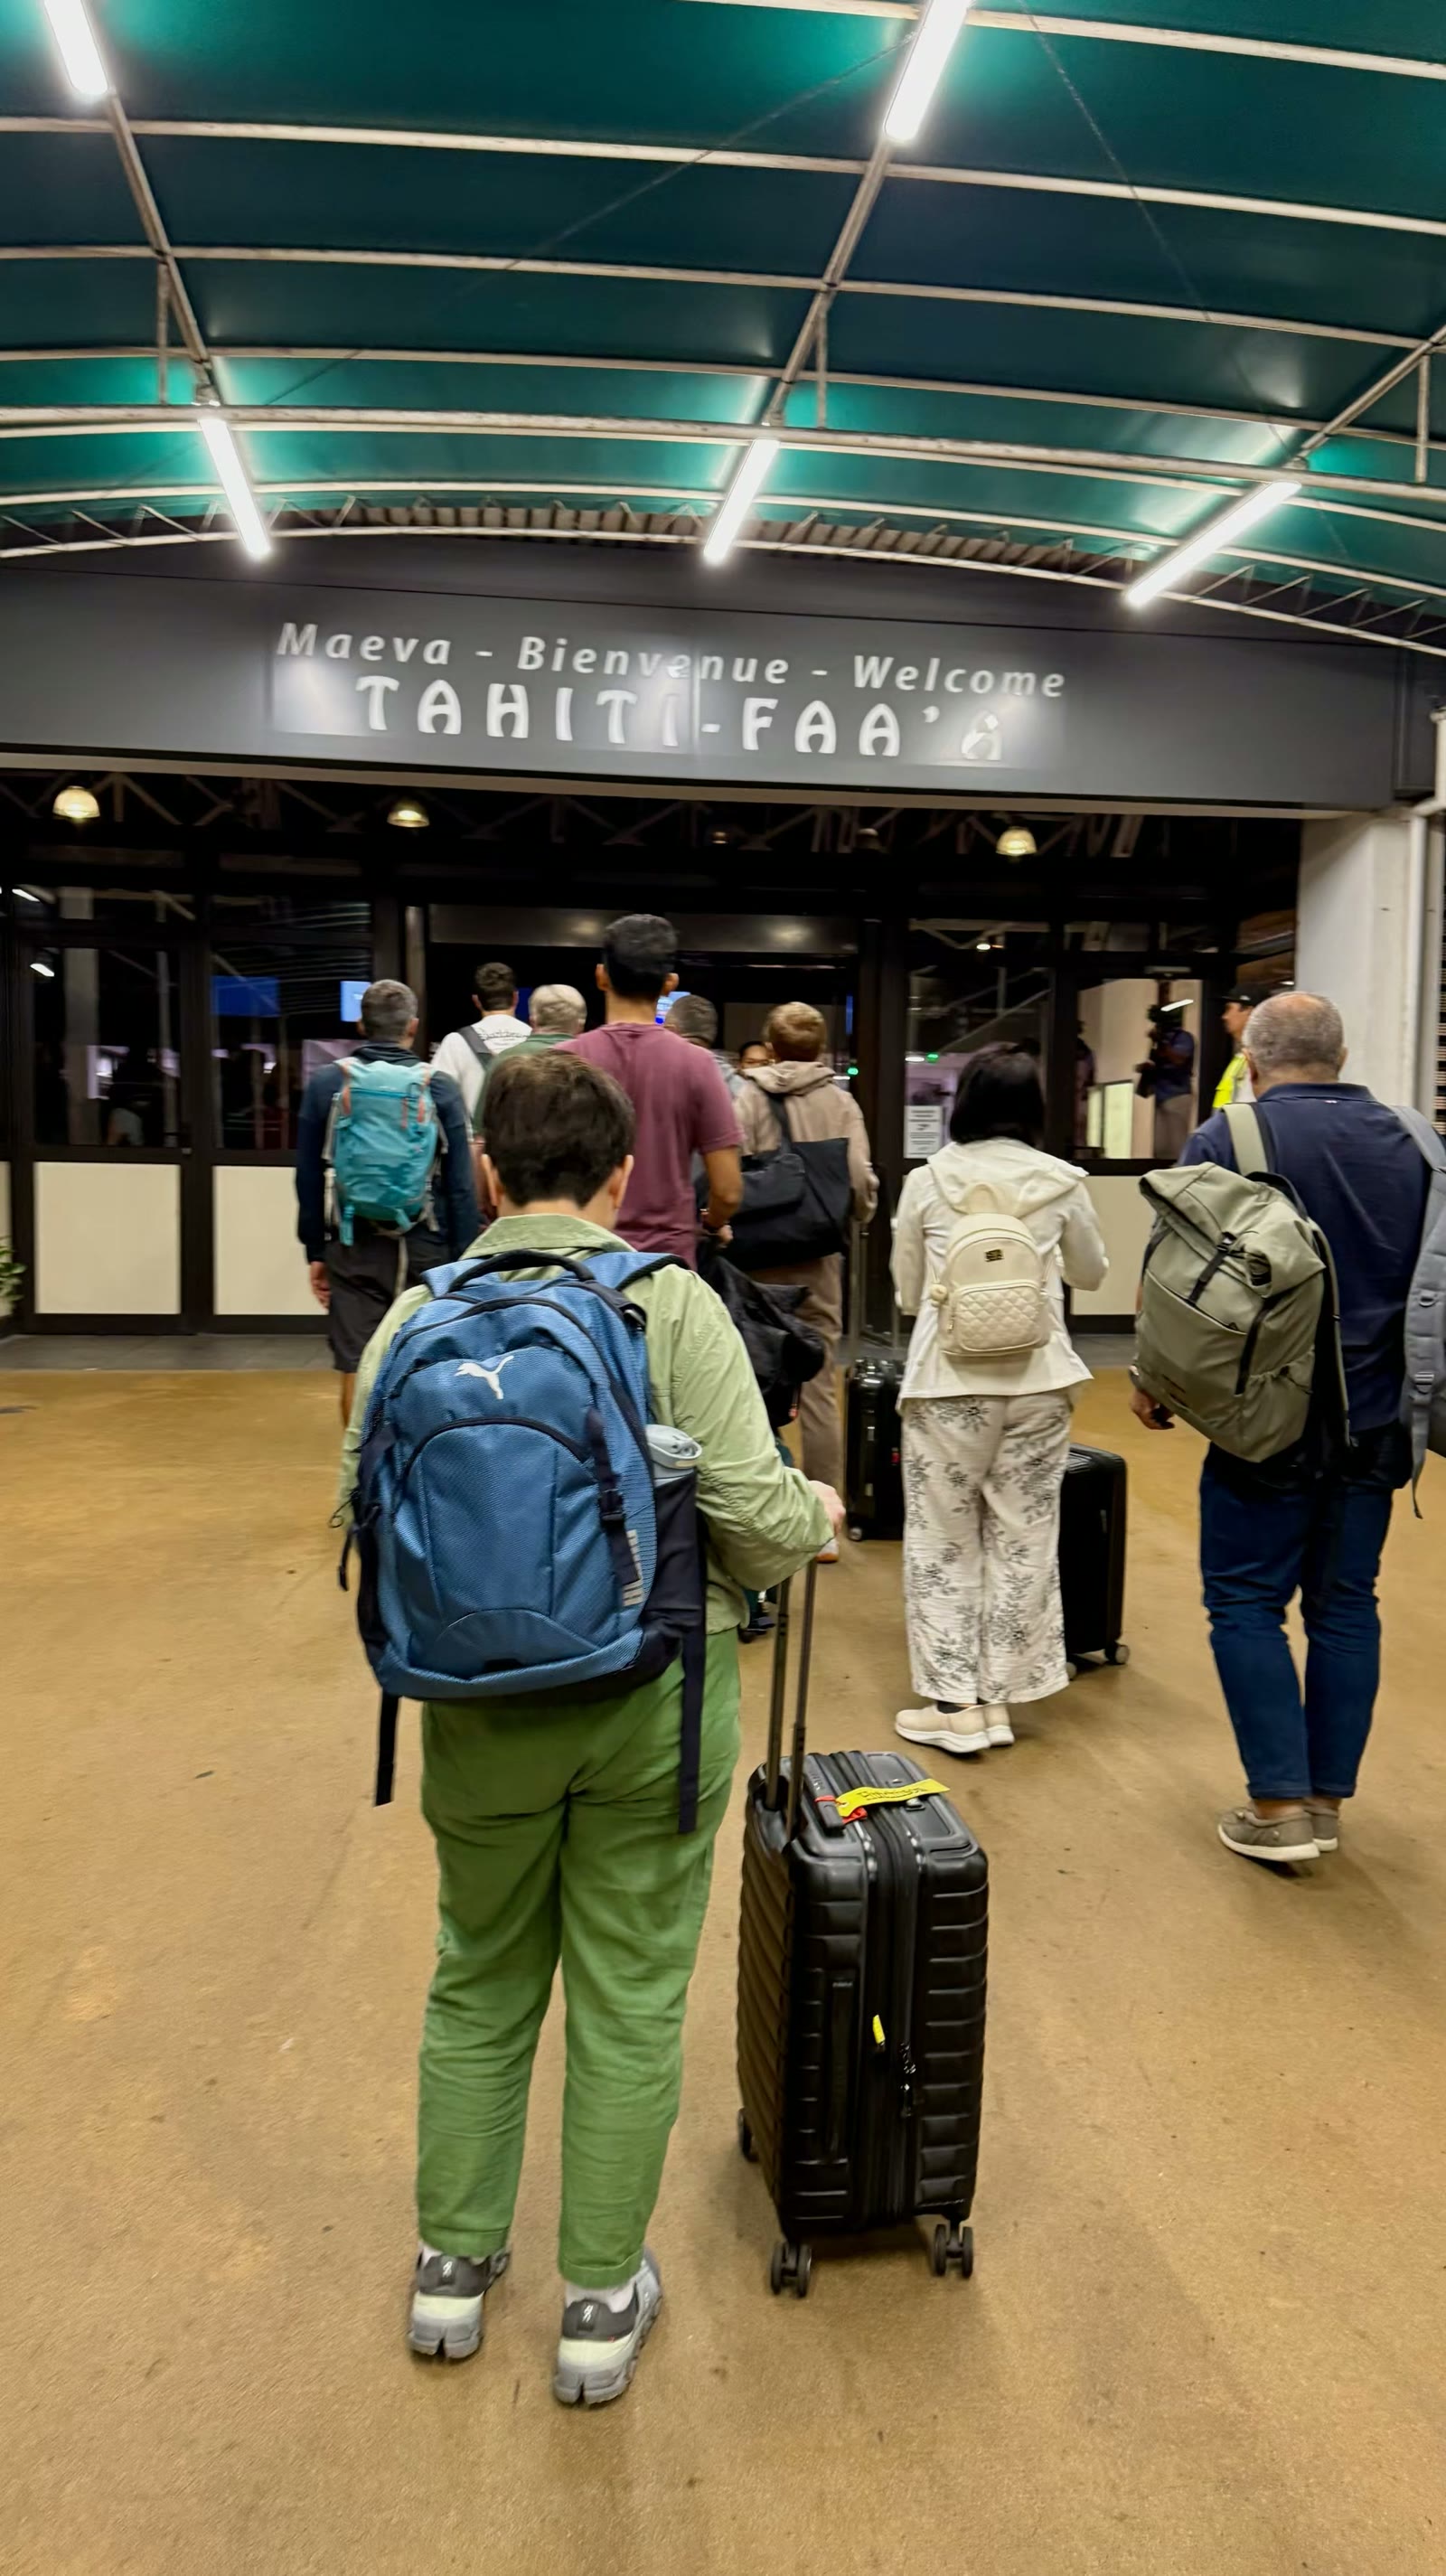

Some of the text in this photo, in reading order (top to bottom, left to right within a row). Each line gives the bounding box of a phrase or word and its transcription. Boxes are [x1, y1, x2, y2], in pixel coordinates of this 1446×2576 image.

[277, 622, 451, 665] Maeva
[517, 635, 789, 684] Bienvenue
[853, 653, 1066, 699] Welcome
